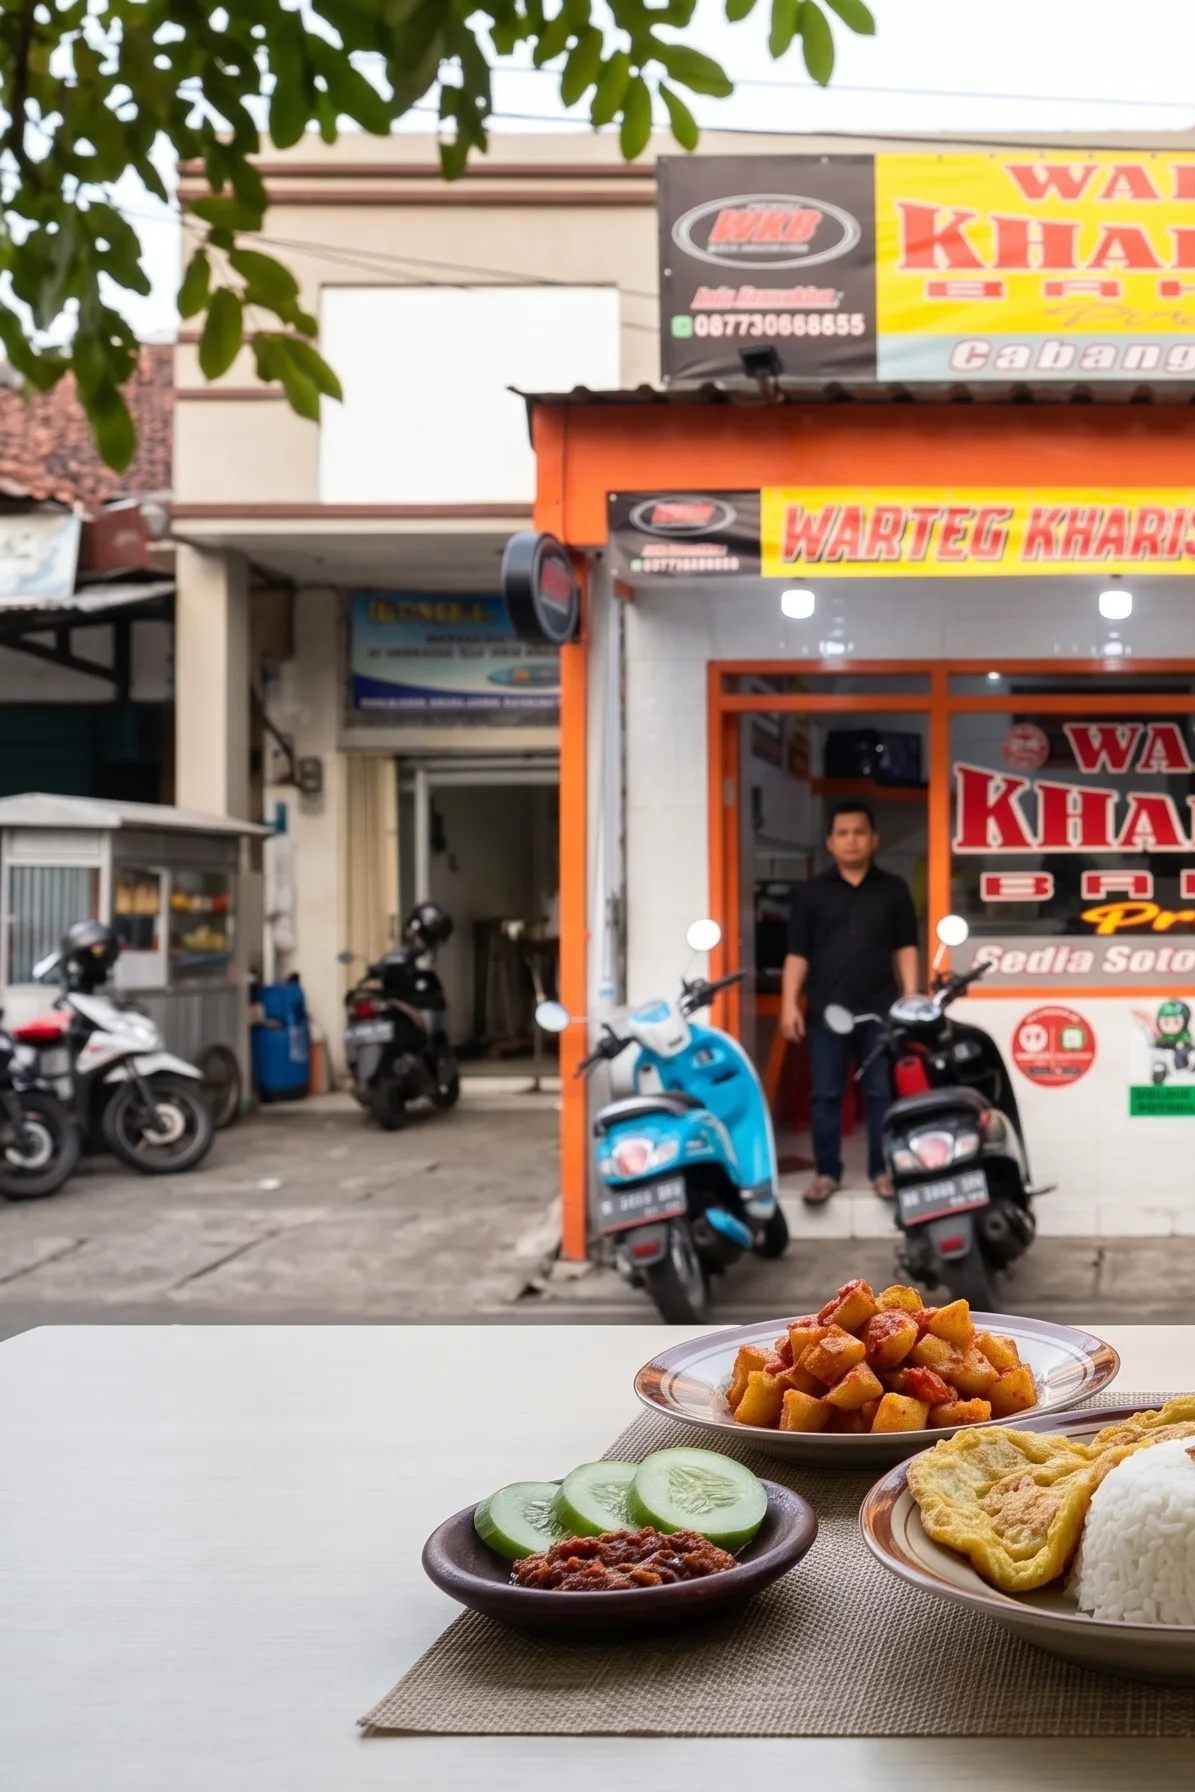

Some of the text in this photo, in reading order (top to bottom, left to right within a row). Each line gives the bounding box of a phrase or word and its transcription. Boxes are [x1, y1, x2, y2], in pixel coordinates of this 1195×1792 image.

[708, 209, 823, 244] WKB
[780, 503, 1016, 564] WARTEG
[972, 944, 1096, 975] Sedia
